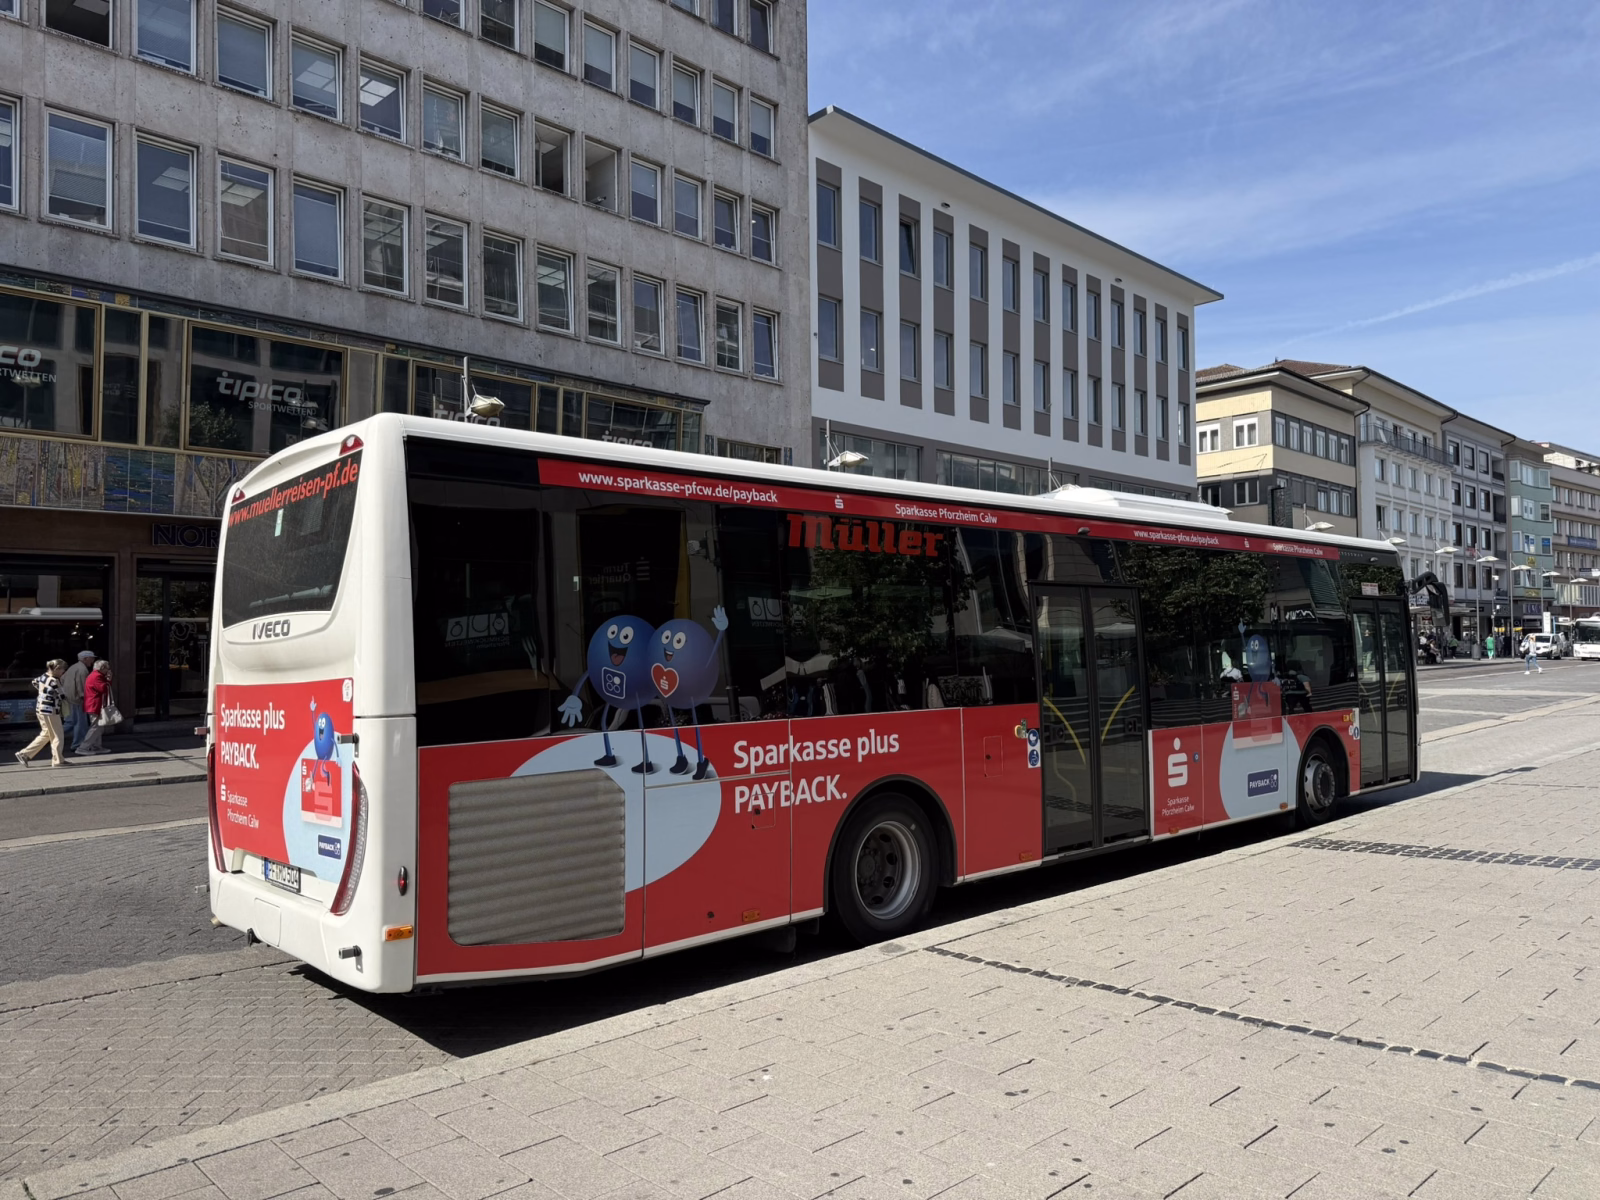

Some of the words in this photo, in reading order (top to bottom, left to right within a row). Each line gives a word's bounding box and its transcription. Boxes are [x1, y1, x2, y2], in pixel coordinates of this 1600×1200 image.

[216, 371, 303, 402] tipico
[248, 401, 313, 416] SPORTWETTEN
[434, 404, 501, 427] tico
[228, 458, 358, 527] www.muellerreisen-pf.de
[578, 472, 778, 503] www.sparkasse-pfcw.de/payback
[895, 503, 937, 519] Sparkasse
[938, 508, 978, 522] Pforzheim
[979, 512, 997, 524] Calw
[787, 513, 944, 557] Müller
[253, 619, 290, 640] IVECO
[221, 702, 262, 733] Sparkasse
[263, 701, 285, 736] plus
[221, 741, 260, 770] PAYBACK.
[733, 735, 851, 774] Sparkasse
[857, 728, 900, 762] plus
[734, 774, 848, 813] PAYBACK.
[1249, 778, 1270, 790] PAYBACK
[227, 790, 248, 807] Sparkasse
[1167, 796, 1189, 807] Sparkasse
[227, 808, 248, 826] Pforzheim
[248, 813, 259, 829] Calw
[1161, 806, 1184, 817] Pforzheim
[1184, 804, 1195, 813] Calw
